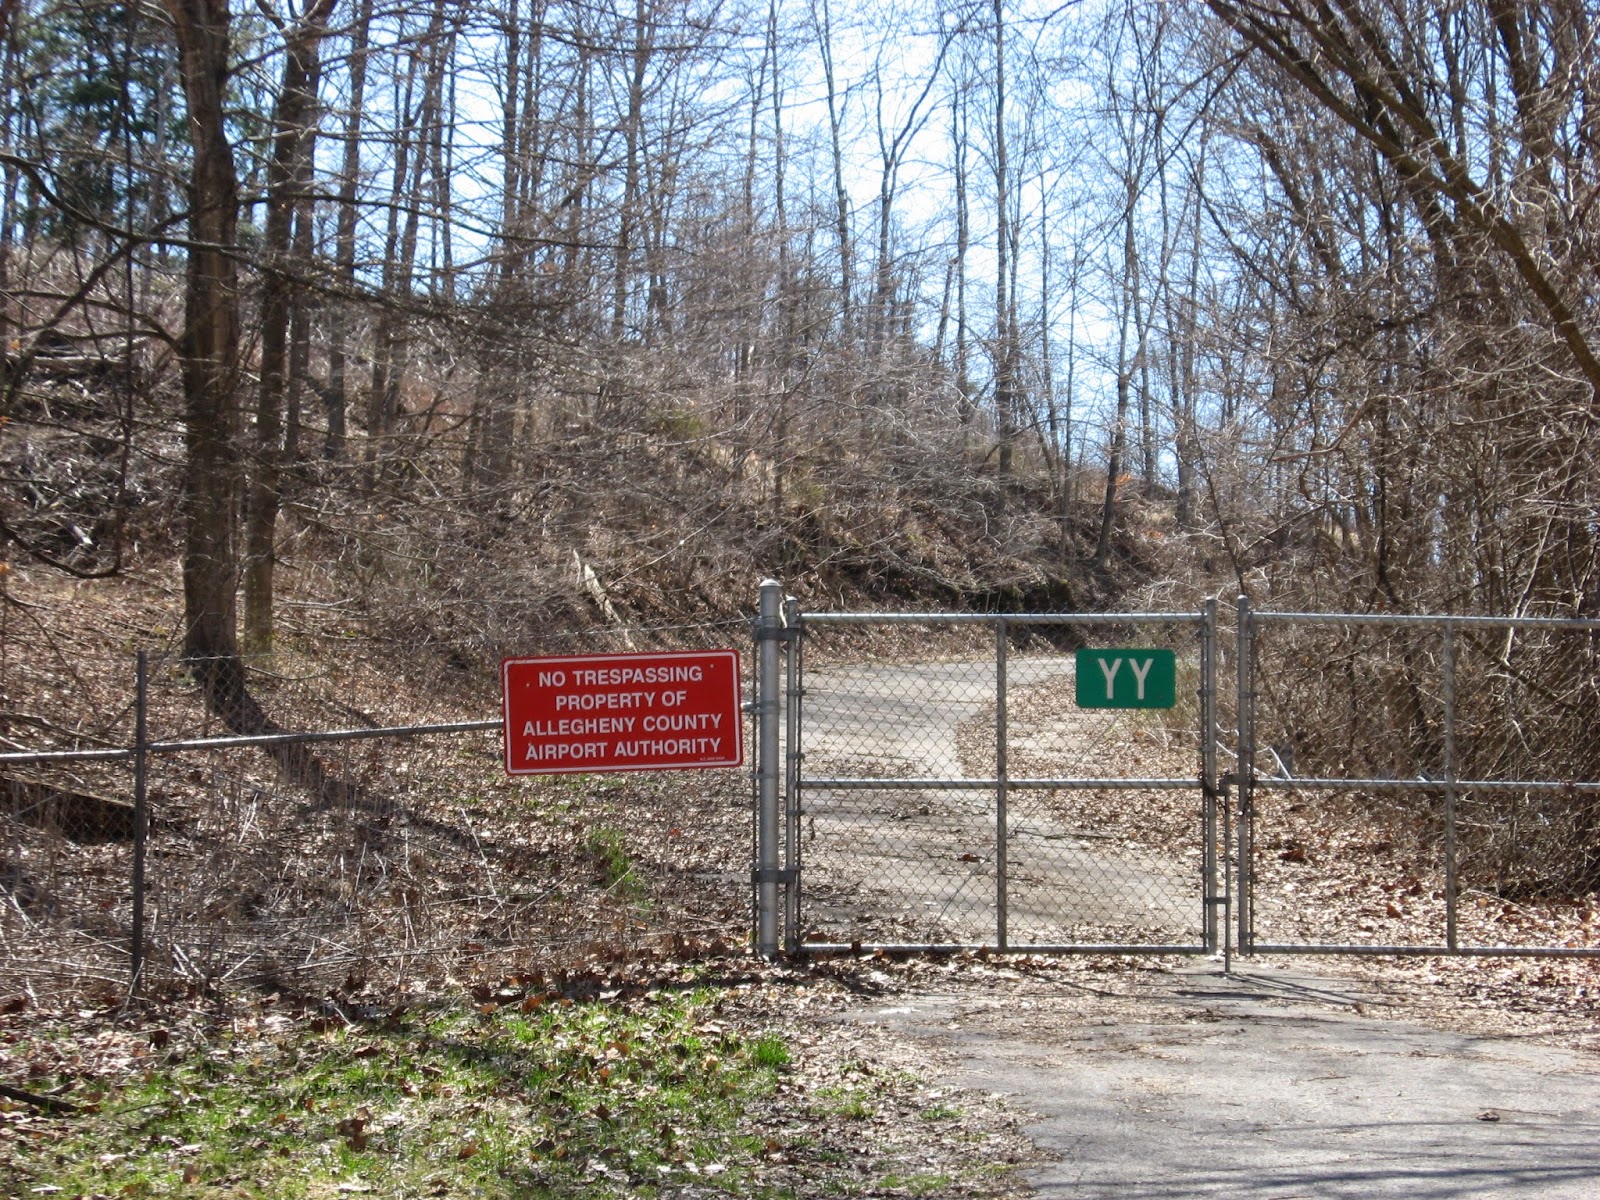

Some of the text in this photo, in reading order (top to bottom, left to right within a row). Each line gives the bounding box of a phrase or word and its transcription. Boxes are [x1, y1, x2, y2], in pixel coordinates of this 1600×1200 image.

[539, 666, 703, 687] NO TRESPASSING
[1097, 658, 1154, 699] YY
[556, 690, 687, 710] PROPERTY OF
[523, 713, 722, 736] ALLEGHENY COUNTY
[525, 738, 721, 760] AIRPORT AUTHORITY
